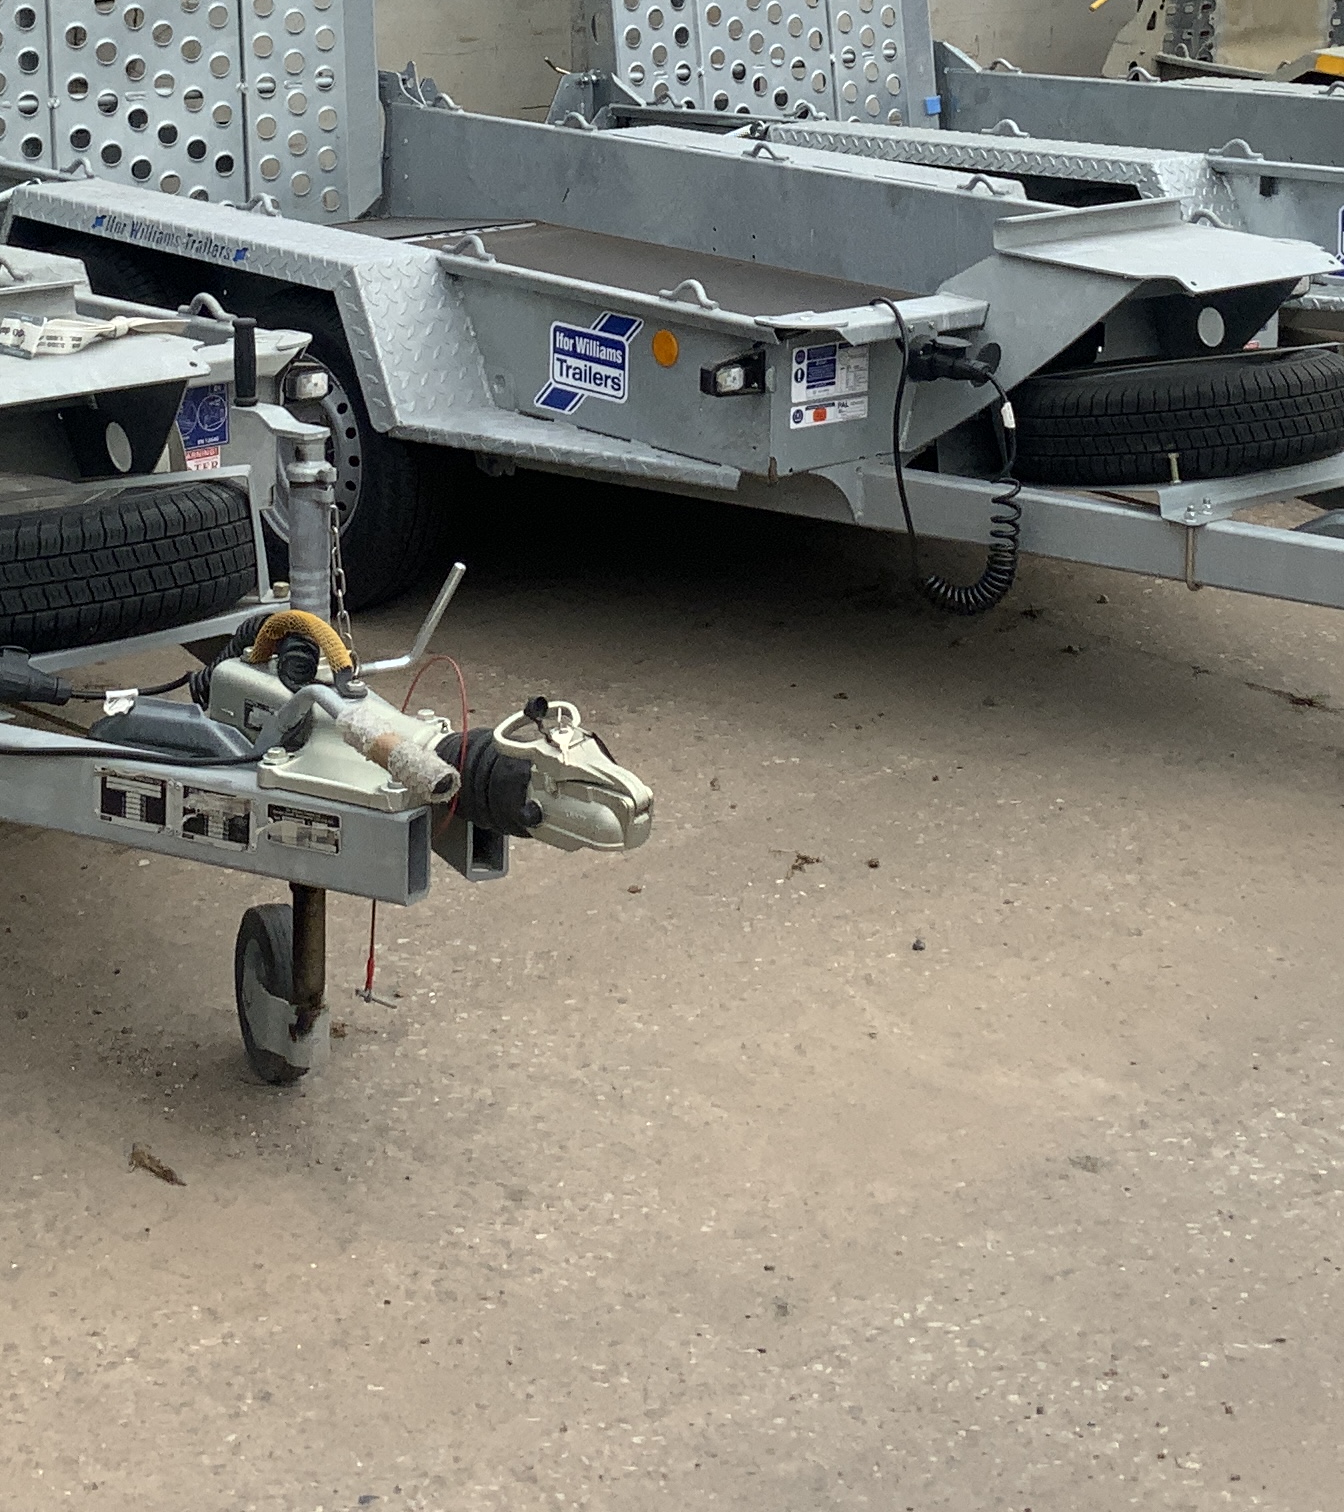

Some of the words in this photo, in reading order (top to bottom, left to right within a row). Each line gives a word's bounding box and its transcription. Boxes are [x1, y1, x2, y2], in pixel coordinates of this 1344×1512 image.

[130, 220, 181, 249] Williams
[184, 232, 233, 261] Trailers
[556, 330, 574, 352] Ifor
[576, 335, 623, 364] Williams
[555, 357, 622, 392] Trailers
